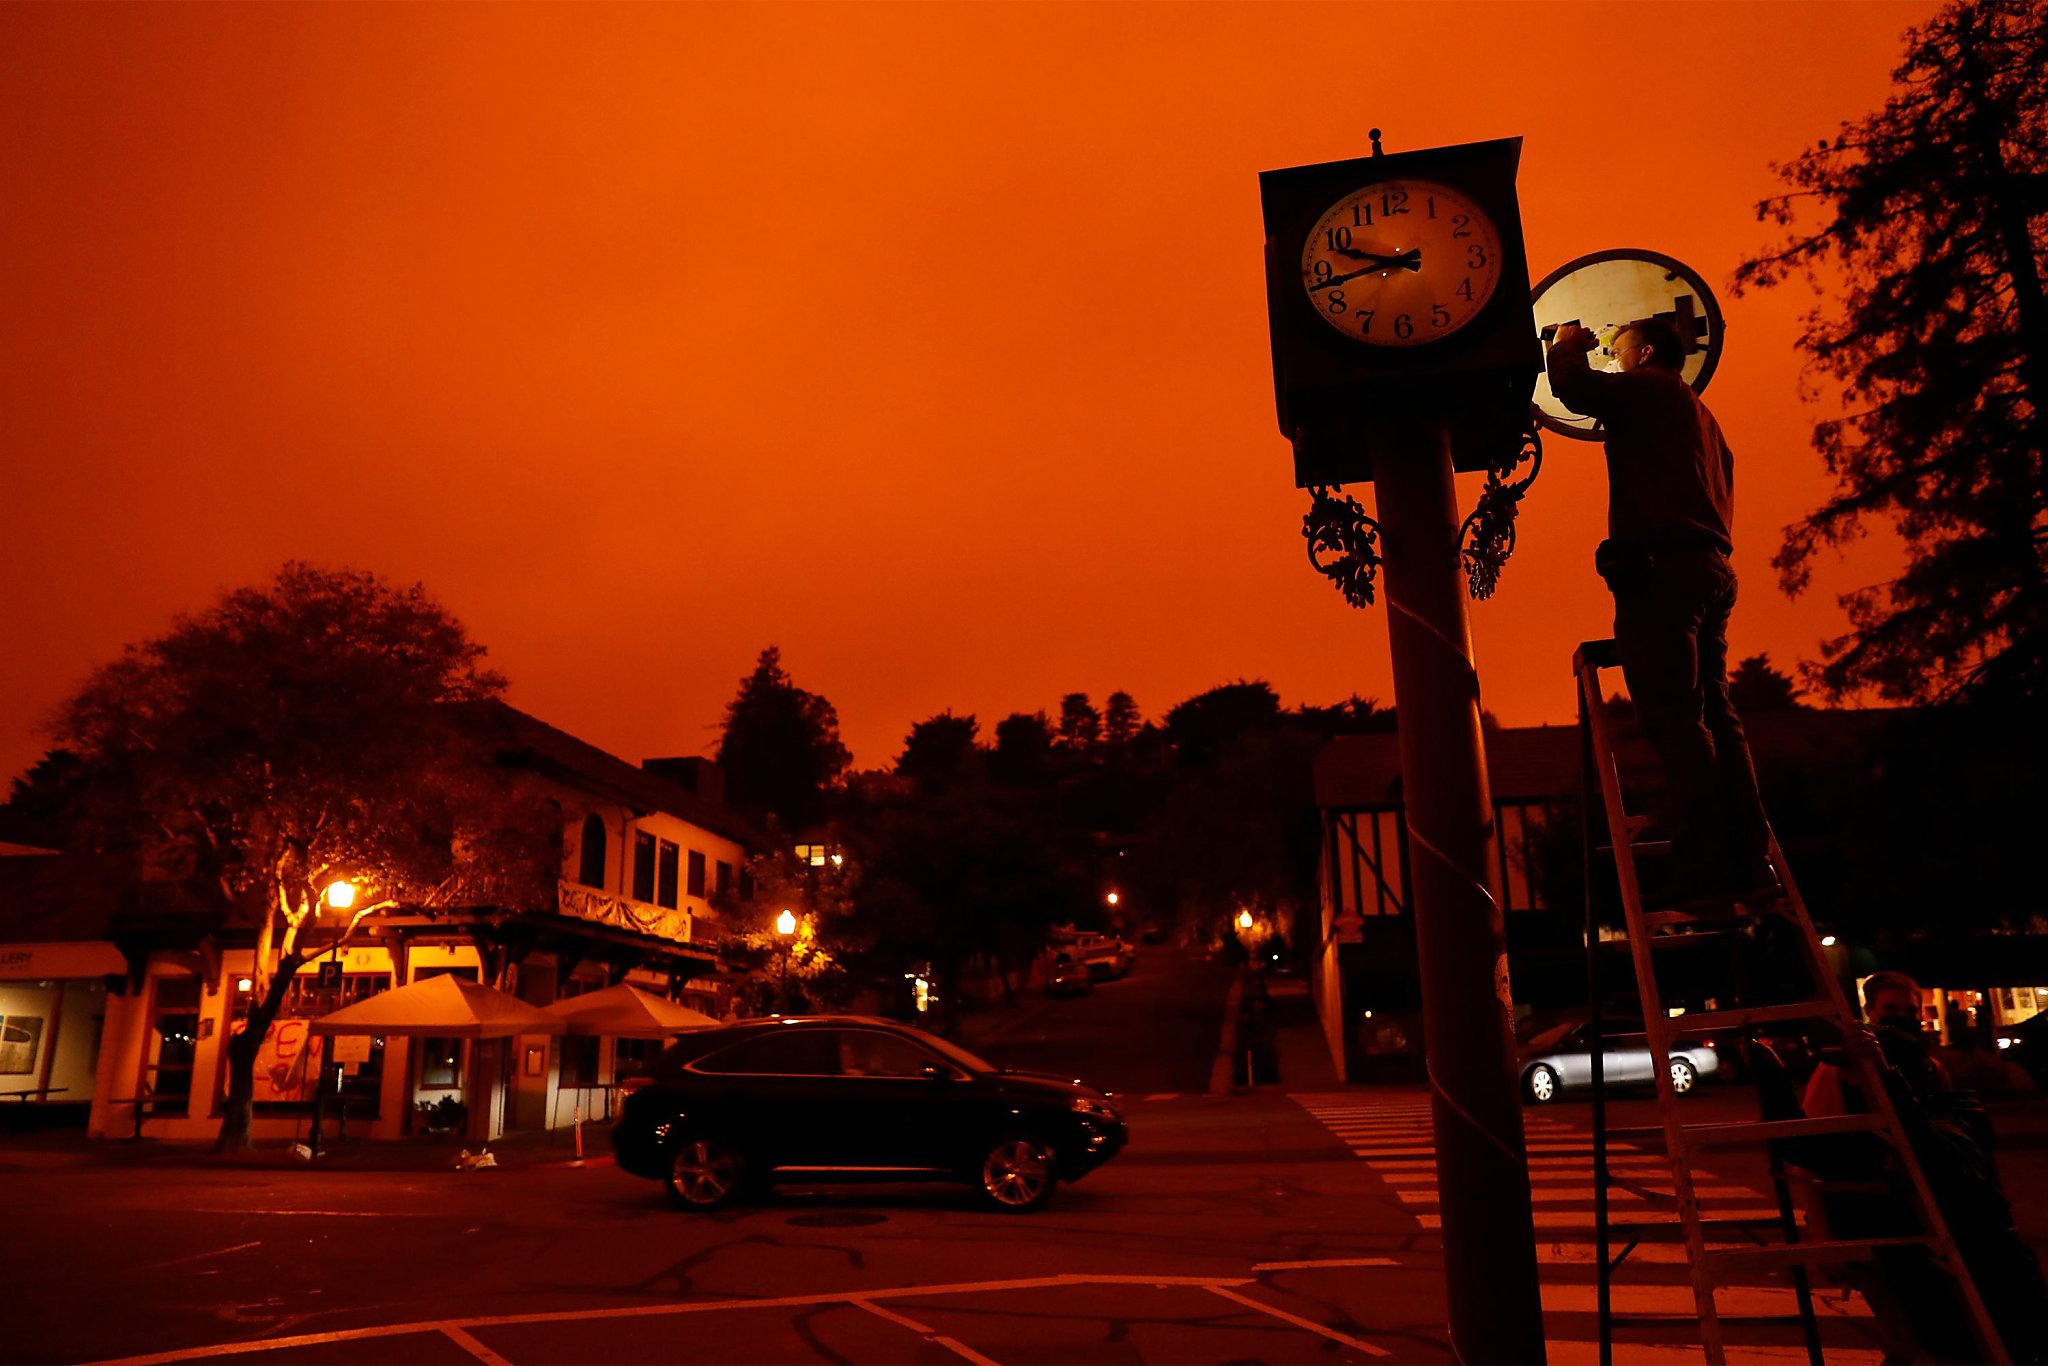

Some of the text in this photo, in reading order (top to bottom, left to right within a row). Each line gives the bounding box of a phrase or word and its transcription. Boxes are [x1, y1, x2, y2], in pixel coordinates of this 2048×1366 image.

[1352, 203, 1374, 226] 11
[1381, 191, 1410, 217] 12
[1427, 196, 1437, 219] 1
[1325, 226, 1352, 251] 10
[1452, 214, 1471, 239] 2
[1467, 245, 1487, 270] 3
[1314, 260, 1333, 284] 9
[1456, 277, 1475, 301] 4
[1328, 290, 1348, 314] 8
[1356, 310, 1375, 334] 7
[1394, 314, 1414, 340] 6
[1432, 303, 1450, 328] 5
